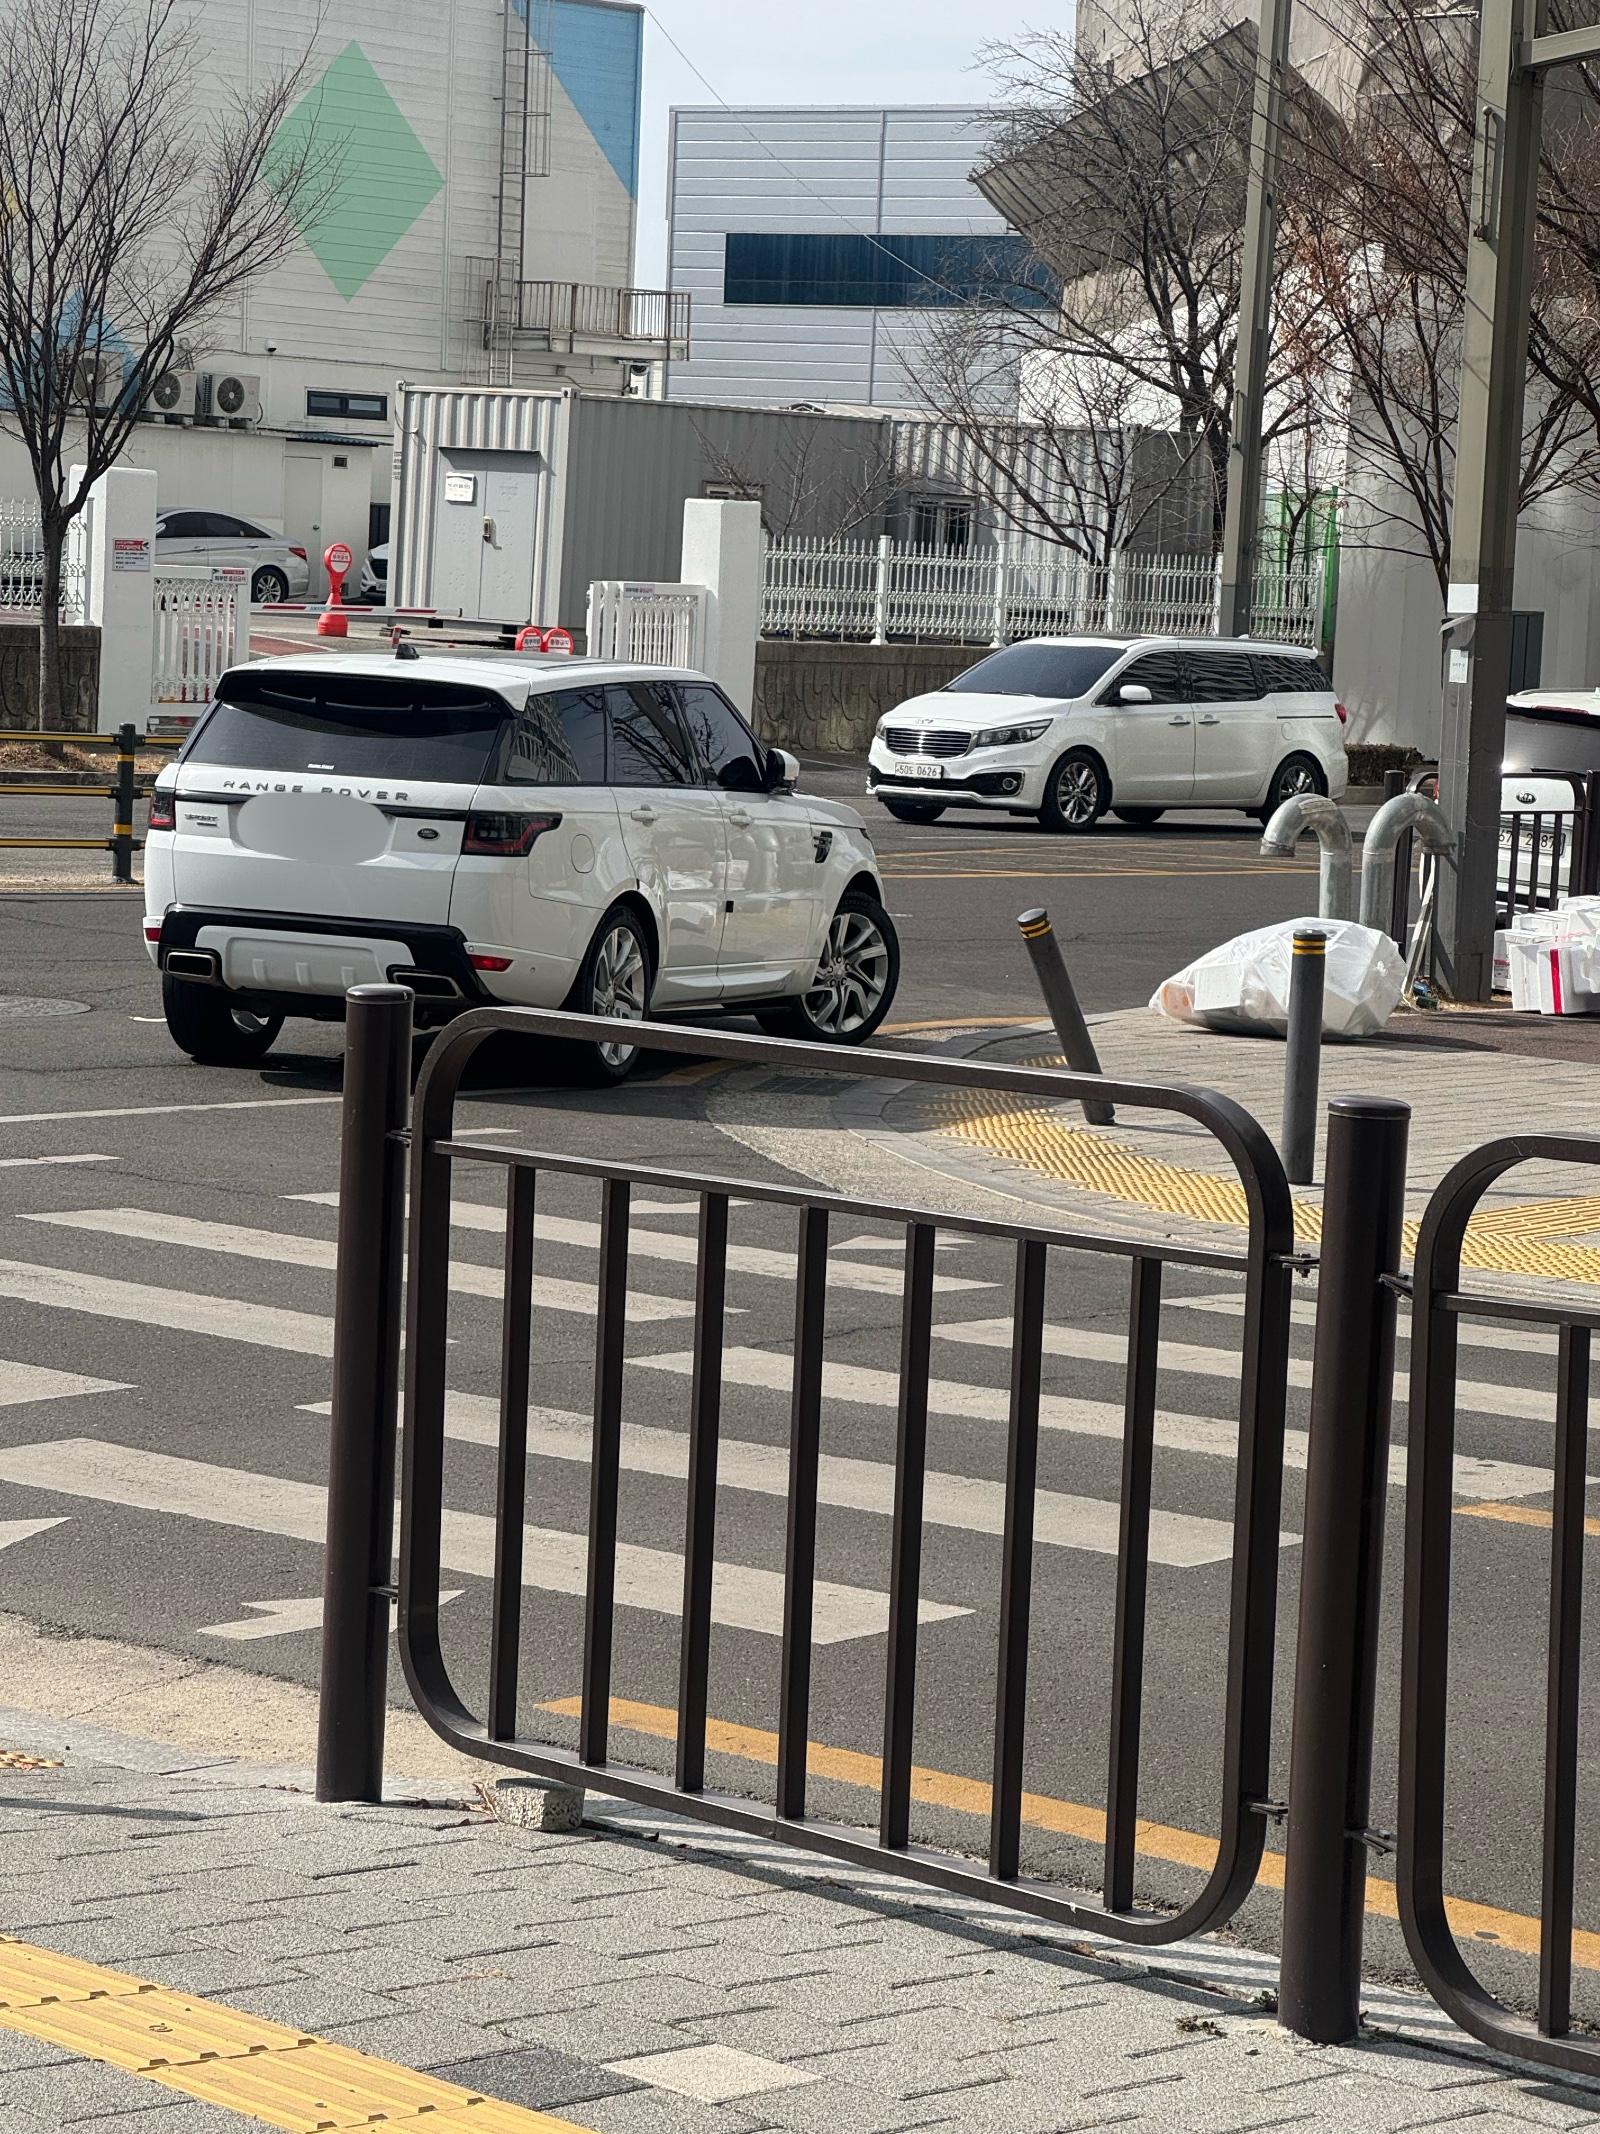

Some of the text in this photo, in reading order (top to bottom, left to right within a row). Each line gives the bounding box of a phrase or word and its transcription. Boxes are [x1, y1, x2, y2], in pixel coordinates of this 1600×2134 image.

[916, 765, 938, 777] 0626
[223, 780, 410, 801] RANGE ROVER
[1525, 832, 1555, 849] 287
